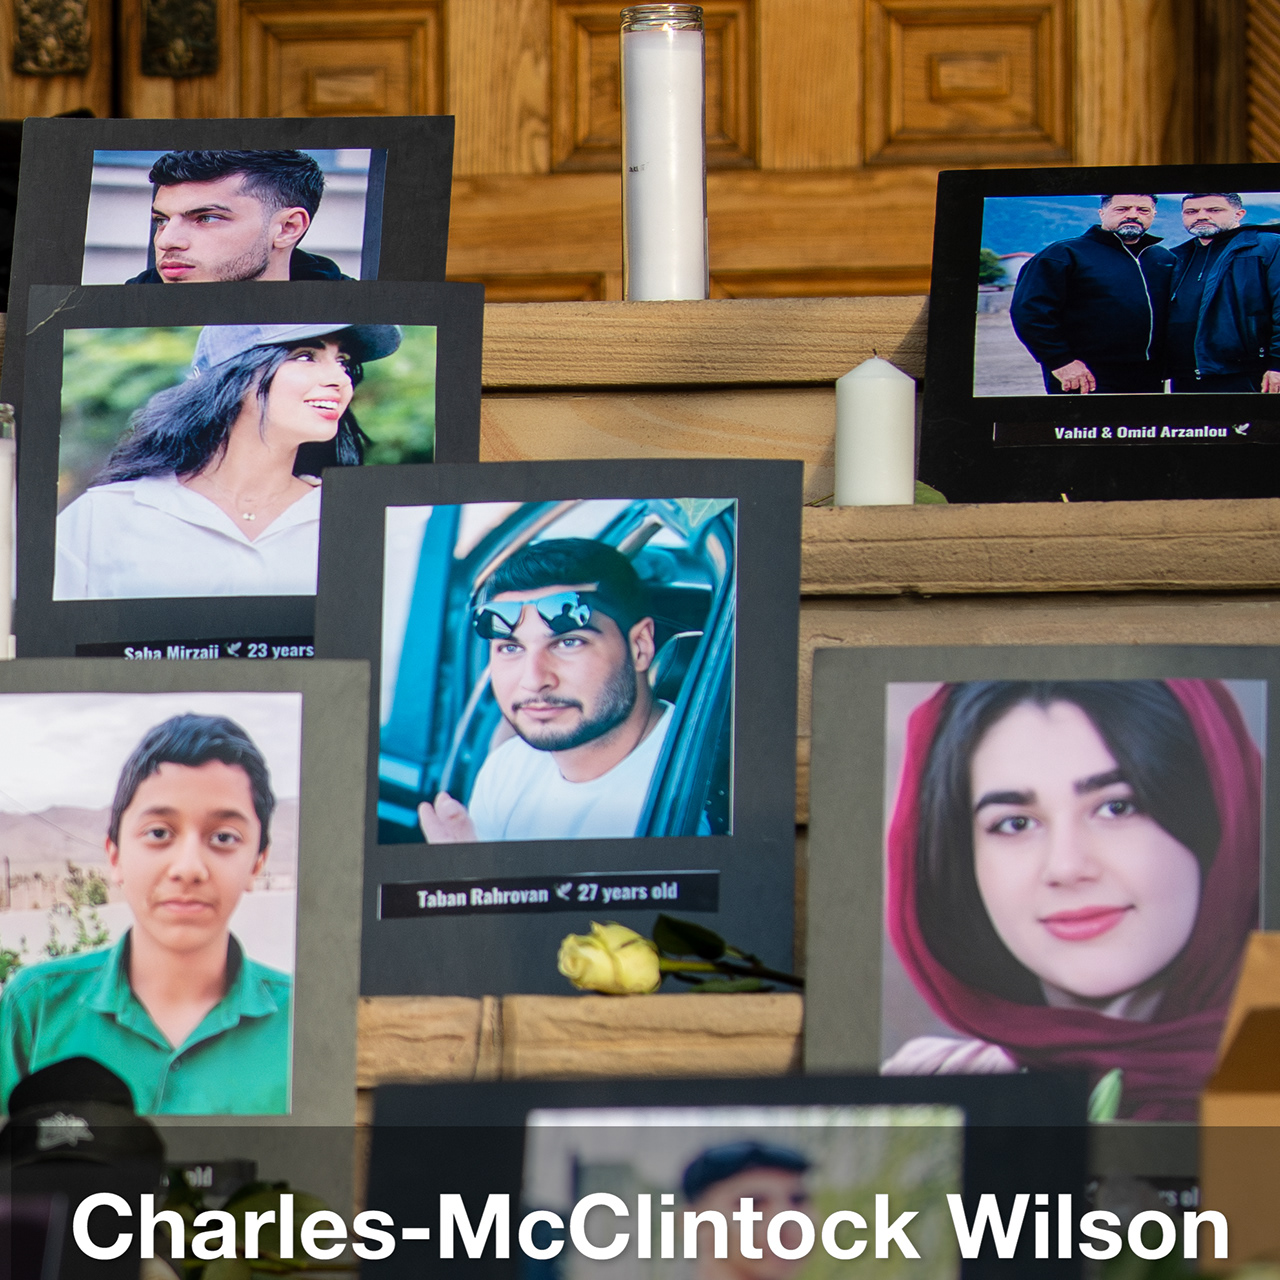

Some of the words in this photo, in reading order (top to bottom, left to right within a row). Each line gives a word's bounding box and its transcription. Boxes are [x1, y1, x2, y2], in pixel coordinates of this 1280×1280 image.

[1055, 427, 1098, 440] Vahid
[1101, 427, 1112, 439] &
[1117, 426, 1156, 439] Omid
[1160, 425, 1228, 438] Arzanlou
[247, 643, 268, 658] 23
[272, 644, 315, 660] years
[417, 889, 467, 908] Taban
[470, 887, 549, 906] Rahrovan
[577, 884, 598, 901] 27
[602, 886, 647, 904] years
[651, 882, 678, 900] old
